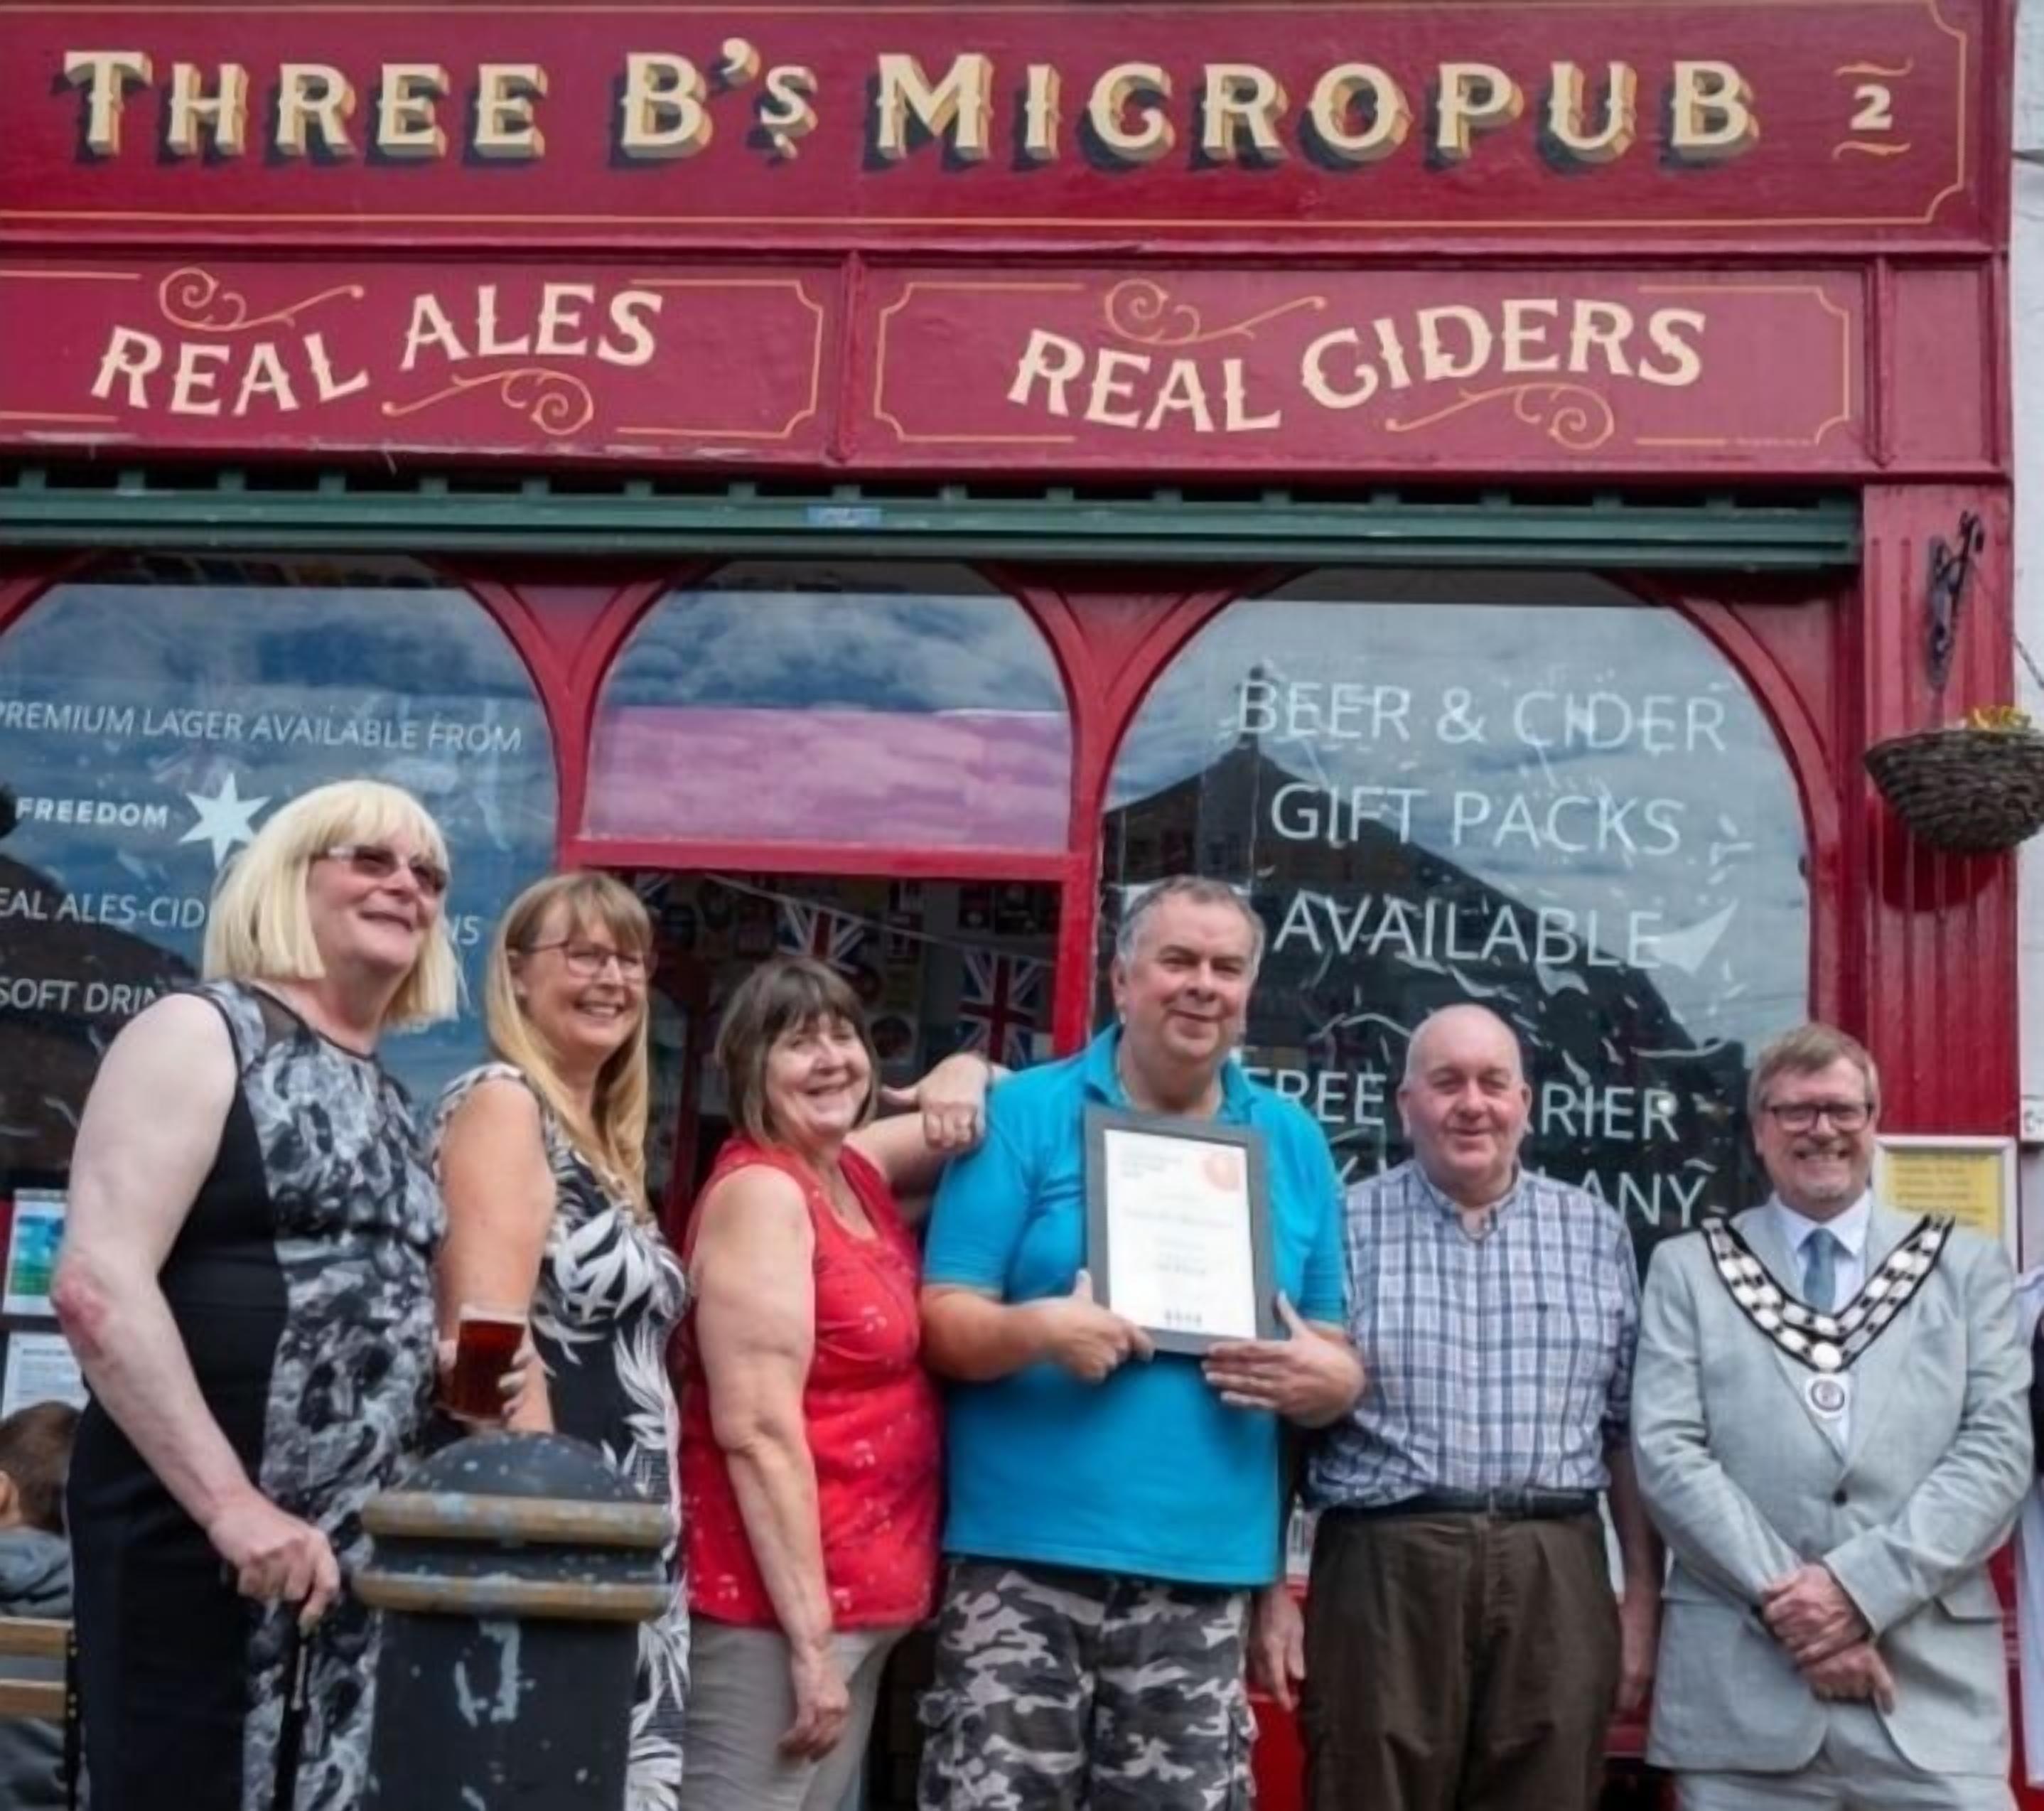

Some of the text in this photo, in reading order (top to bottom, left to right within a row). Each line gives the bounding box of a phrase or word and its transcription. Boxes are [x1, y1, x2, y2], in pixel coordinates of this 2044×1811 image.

[61, 37, 1893, 161] THREE B's MICROPUB 2
[91, 283, 663, 416] REAL ALES
[1007, 299, 1706, 432] REAL CIDERS
[142, 707, 244, 741] LAGER
[249, 712, 421, 751] AVAILABLE
[428, 719, 522, 754] FROM
[1238, 680, 1727, 751] BEER & CIDER
[16, 796, 170, 829] FREEDOM
[1271, 783, 1686, 854] GIFT PACKS
[0, 886, 206, 928] EAL ALES-CID
[1274, 894, 1663, 969] AVAILABLE
[0, 976, 78, 1013] SOFT
[1527, 1080, 1680, 1142] RIER
